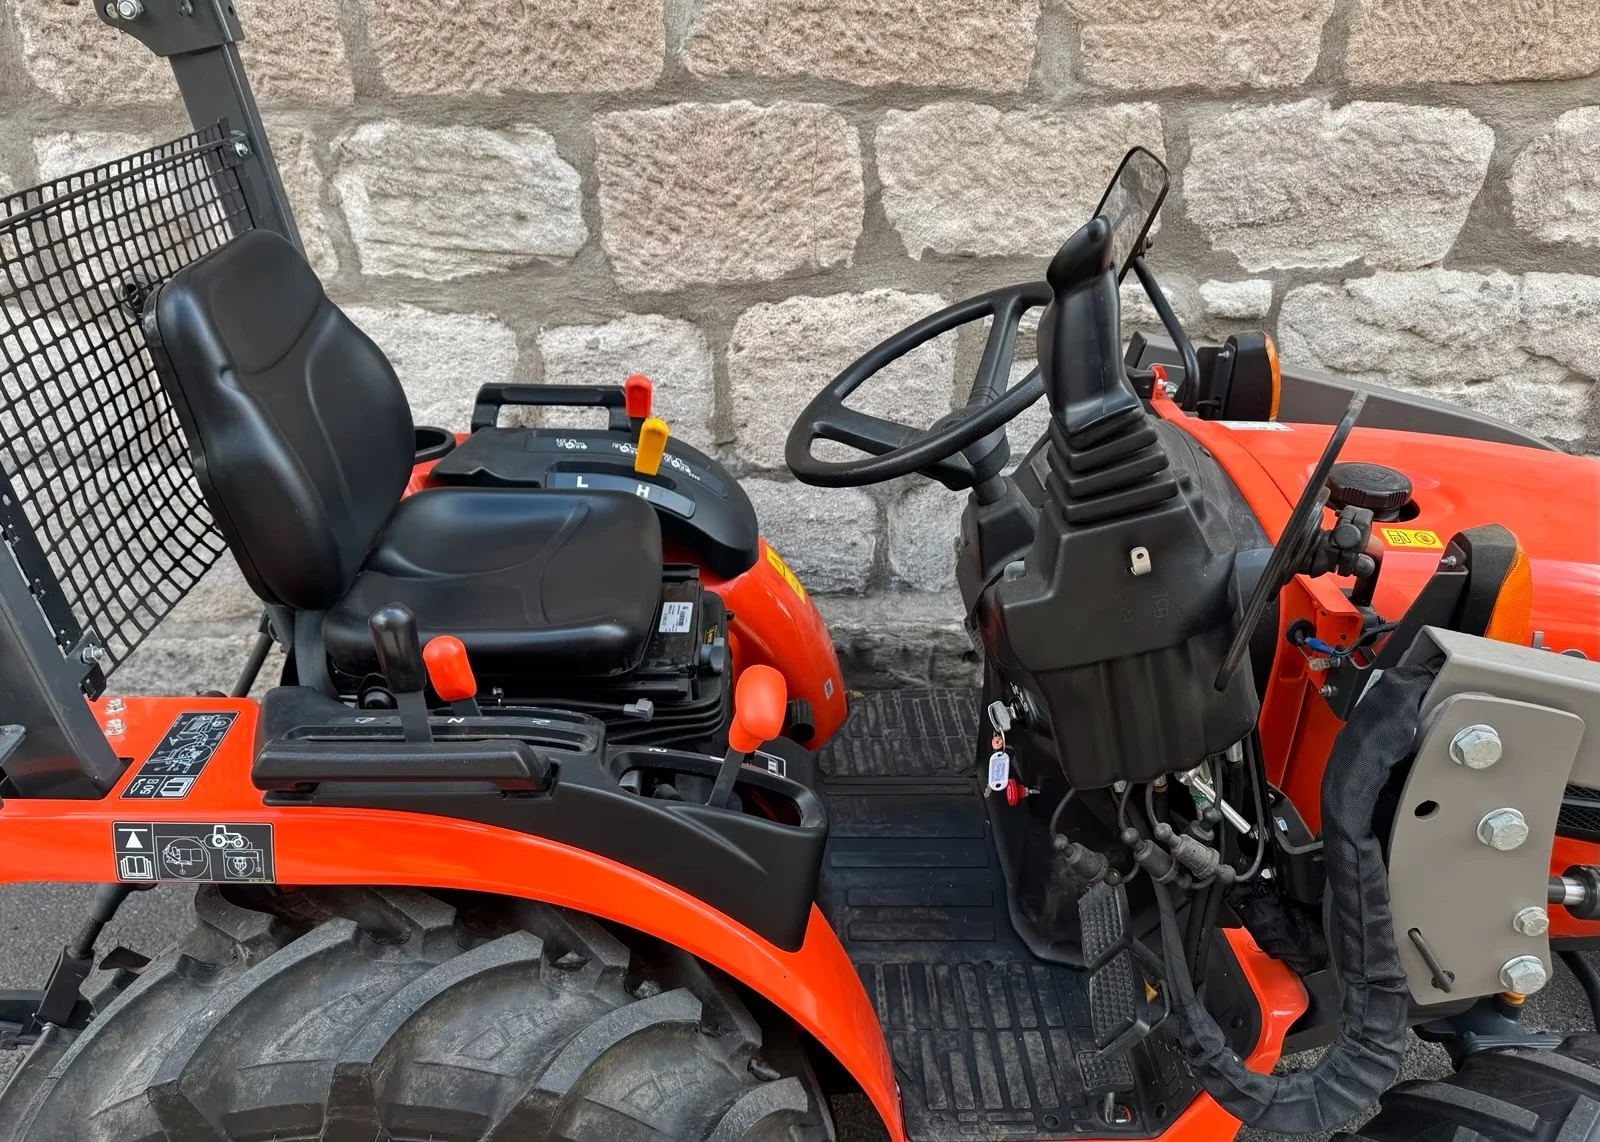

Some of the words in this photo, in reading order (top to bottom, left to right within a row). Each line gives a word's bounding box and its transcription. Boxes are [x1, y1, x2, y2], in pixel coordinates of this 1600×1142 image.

[576, 476, 589, 488] L
[635, 484, 650, 499] H
[139, 784, 155, 795] 50
